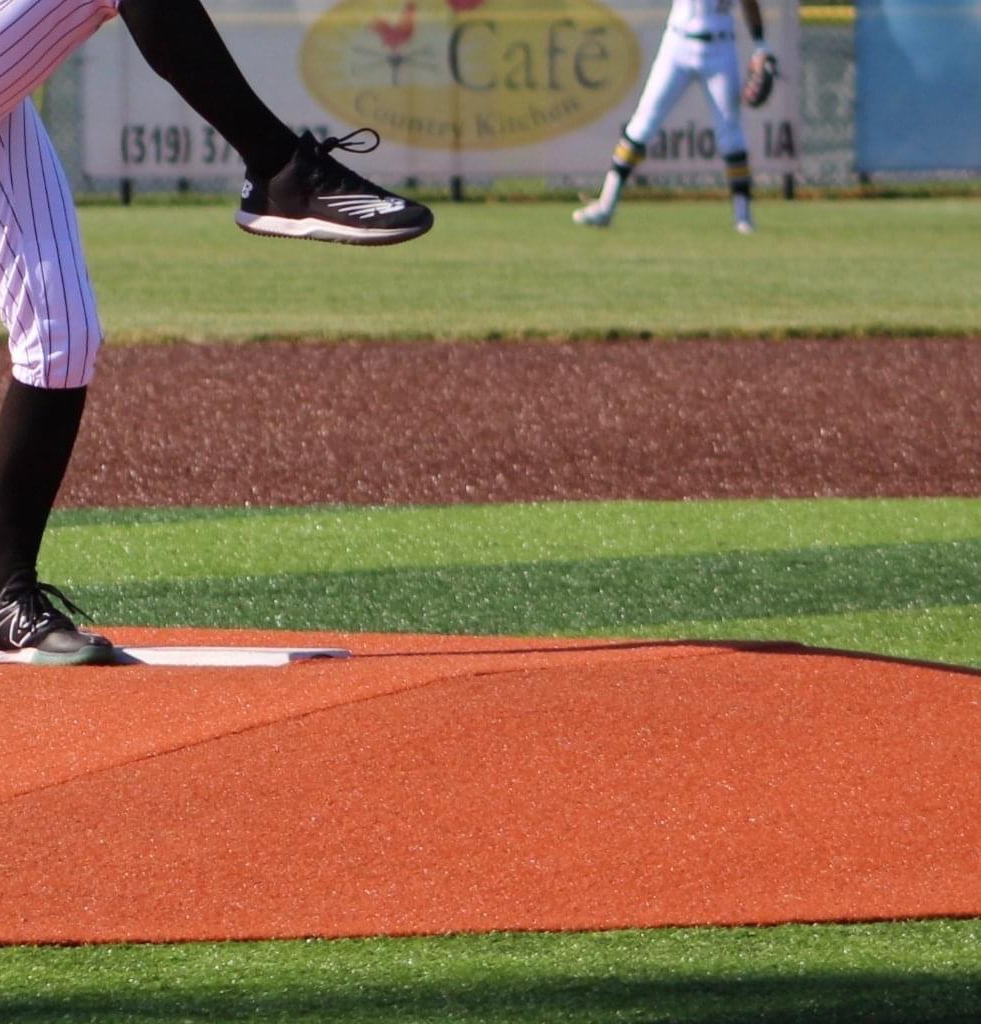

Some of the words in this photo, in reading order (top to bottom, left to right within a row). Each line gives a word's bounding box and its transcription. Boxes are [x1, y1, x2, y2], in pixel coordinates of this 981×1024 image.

[448, 18, 610, 91] Café
[120, 125, 191, 164] (319)
[621, 123, 719, 160] ario
[763, 122, 797, 159] IA
